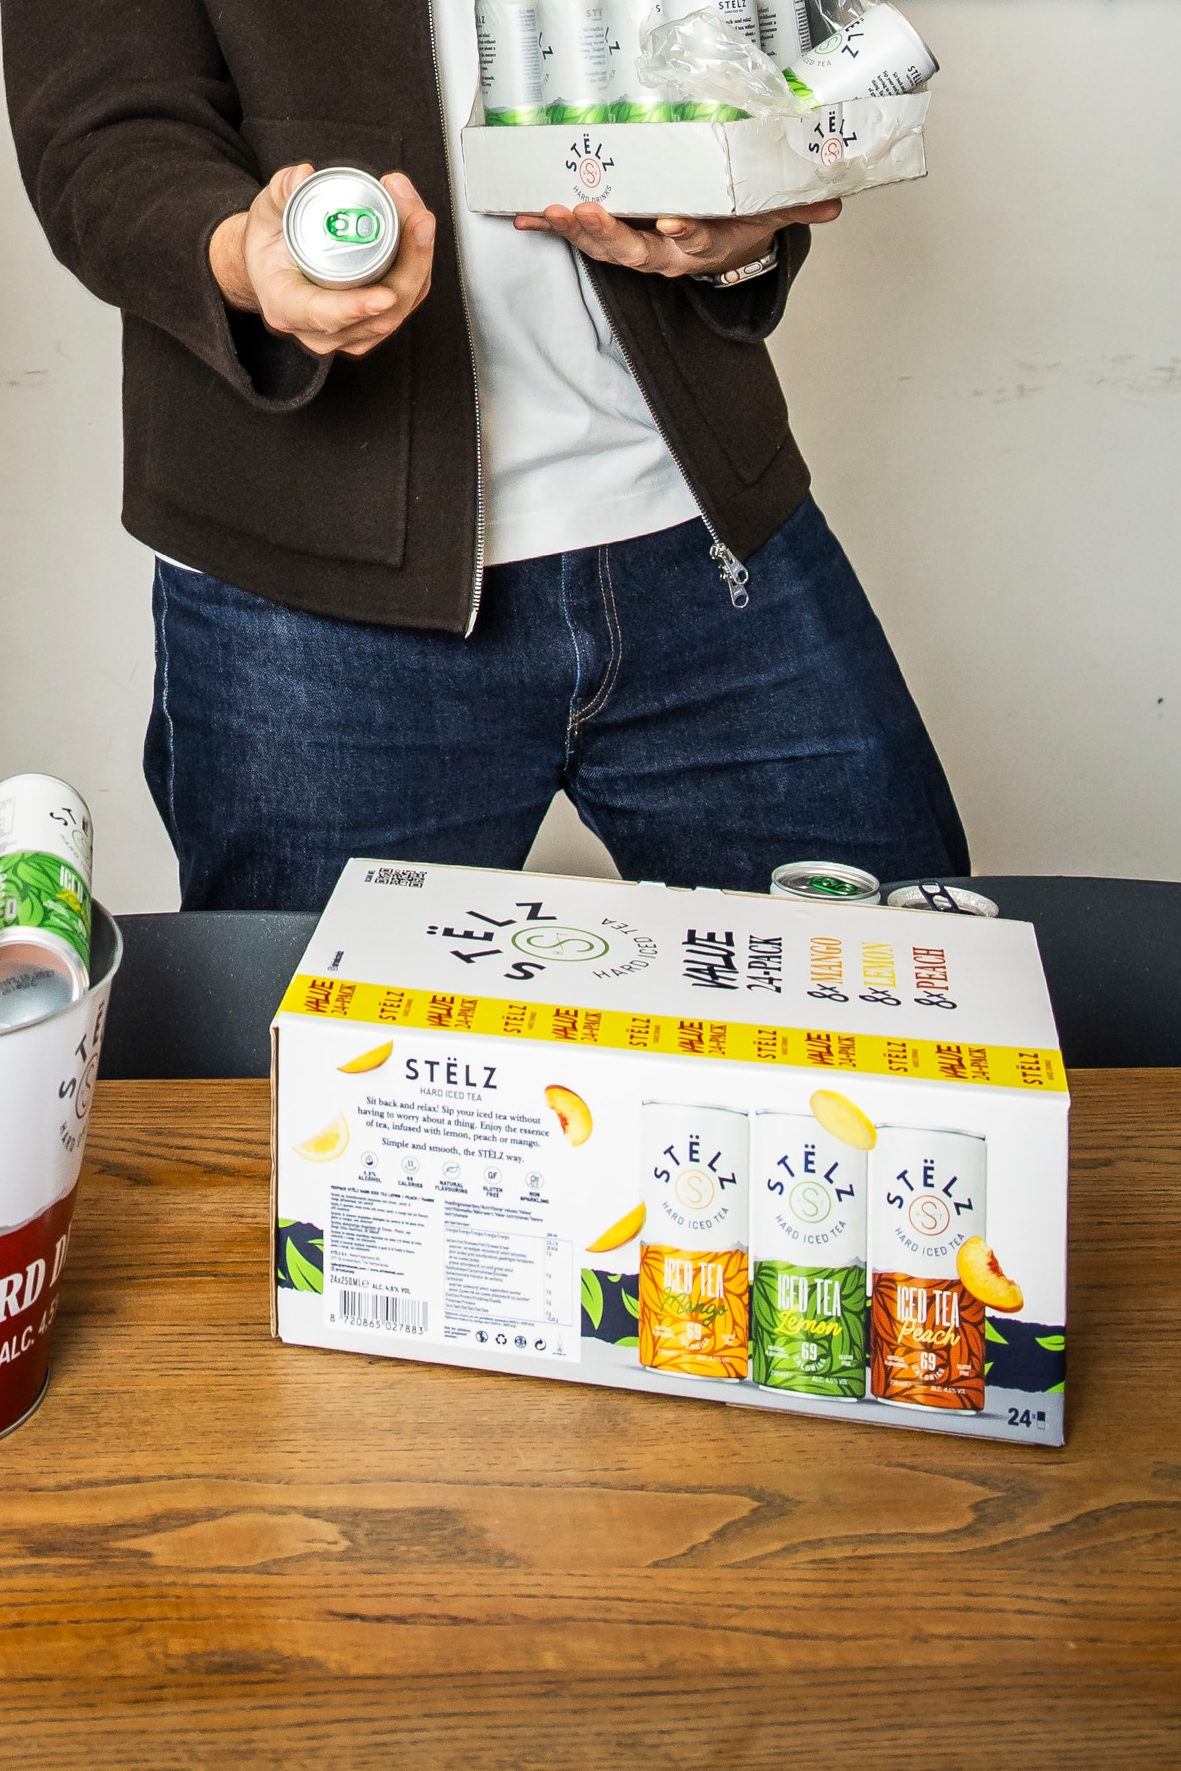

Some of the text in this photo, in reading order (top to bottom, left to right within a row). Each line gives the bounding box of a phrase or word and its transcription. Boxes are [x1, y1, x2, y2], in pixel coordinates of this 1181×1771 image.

[566, 133, 615, 172] STËLZ
[573, 185, 612, 203] HARD DRINKS
[426, 902, 557, 980] STËLZ
[593, 918, 658, 979] HARD ICED TEA
[682, 929, 739, 990] VALUE
[746, 935, 783, 994] 24-PACK
[807, 937, 849, 1003] 8x MANGO
[858, 941, 901, 1007] 8x LEMON
[912, 946, 957, 1009] 8x PEACH
[379, 991, 405, 1021] STËLZ
[501, 1005, 527, 1034] STËLZ
[626, 1017, 651, 1047] STËLZ
[754, 1030, 777, 1060] STËLZ
[883, 1041, 908, 1072] STËLZ
[1016, 1053, 1043, 1085] STËLZ
[406, 1057, 498, 1089] STËLZ
[420, 1087, 482, 1101] HARD ICED TEA
[358, 1107, 384, 1119] having
[397, 1114, 419, 1124] worry
[422, 1115, 445, 1124] about
[454, 1118, 477, 1130] thing.
[480, 1122, 502, 1133] Enjoy
[505, 1124, 517, 1133] the
[367, 1096, 376, 1104] Sit
[379, 1098, 398, 1107] back
[400, 1100, 415, 1109] and
[417, 1102, 439, 1112] relax!
[442, 1105, 454, 1116] Sip
[457, 1110, 474, 1119] your
[477, 1109, 493, 1118] iced
[509, 1114, 541, 1124] without
[366, 1119, 374, 1127] of
[376, 1122, 390, 1130] tea,
[393, 1123, 421, 1132] infused
[424, 1126, 441, 1135] with
[443, 1129, 471, 1140] lemon,
[474, 1132, 497, 1144] peach
[511, 1139, 540, 1149] mango.
[382, 1138, 524, 1164] Simple and smooth, the STËLZ way.
[654, 1134, 737, 1190] STËLZ
[440, 1180, 463, 1188] NATURAL
[767, 1144, 855, 1202] STËLZ
[886, 1158, 973, 1215] STËLZ
[662, 1201, 729, 1230] HARD ICED TEA
[775, 1214, 847, 1244] HARD ICED TEA
[894, 1227, 965, 1257] HARD ICED TEA
[664, 1258, 724, 1299] ICED TEA
[660, 1287, 728, 1327] Mango
[777, 1274, 842, 1317] ICED TEA
[896, 1286, 960, 1328] ICED TEA
[330, 1314, 423, 1335] 8 720865 027883
[686, 1322, 702, 1341] 69
[775, 1305, 843, 1337] Lemon
[898, 1318, 961, 1346] Peach
[801, 1342, 818, 1361] 69
[920, 1352, 936, 1371] 69
